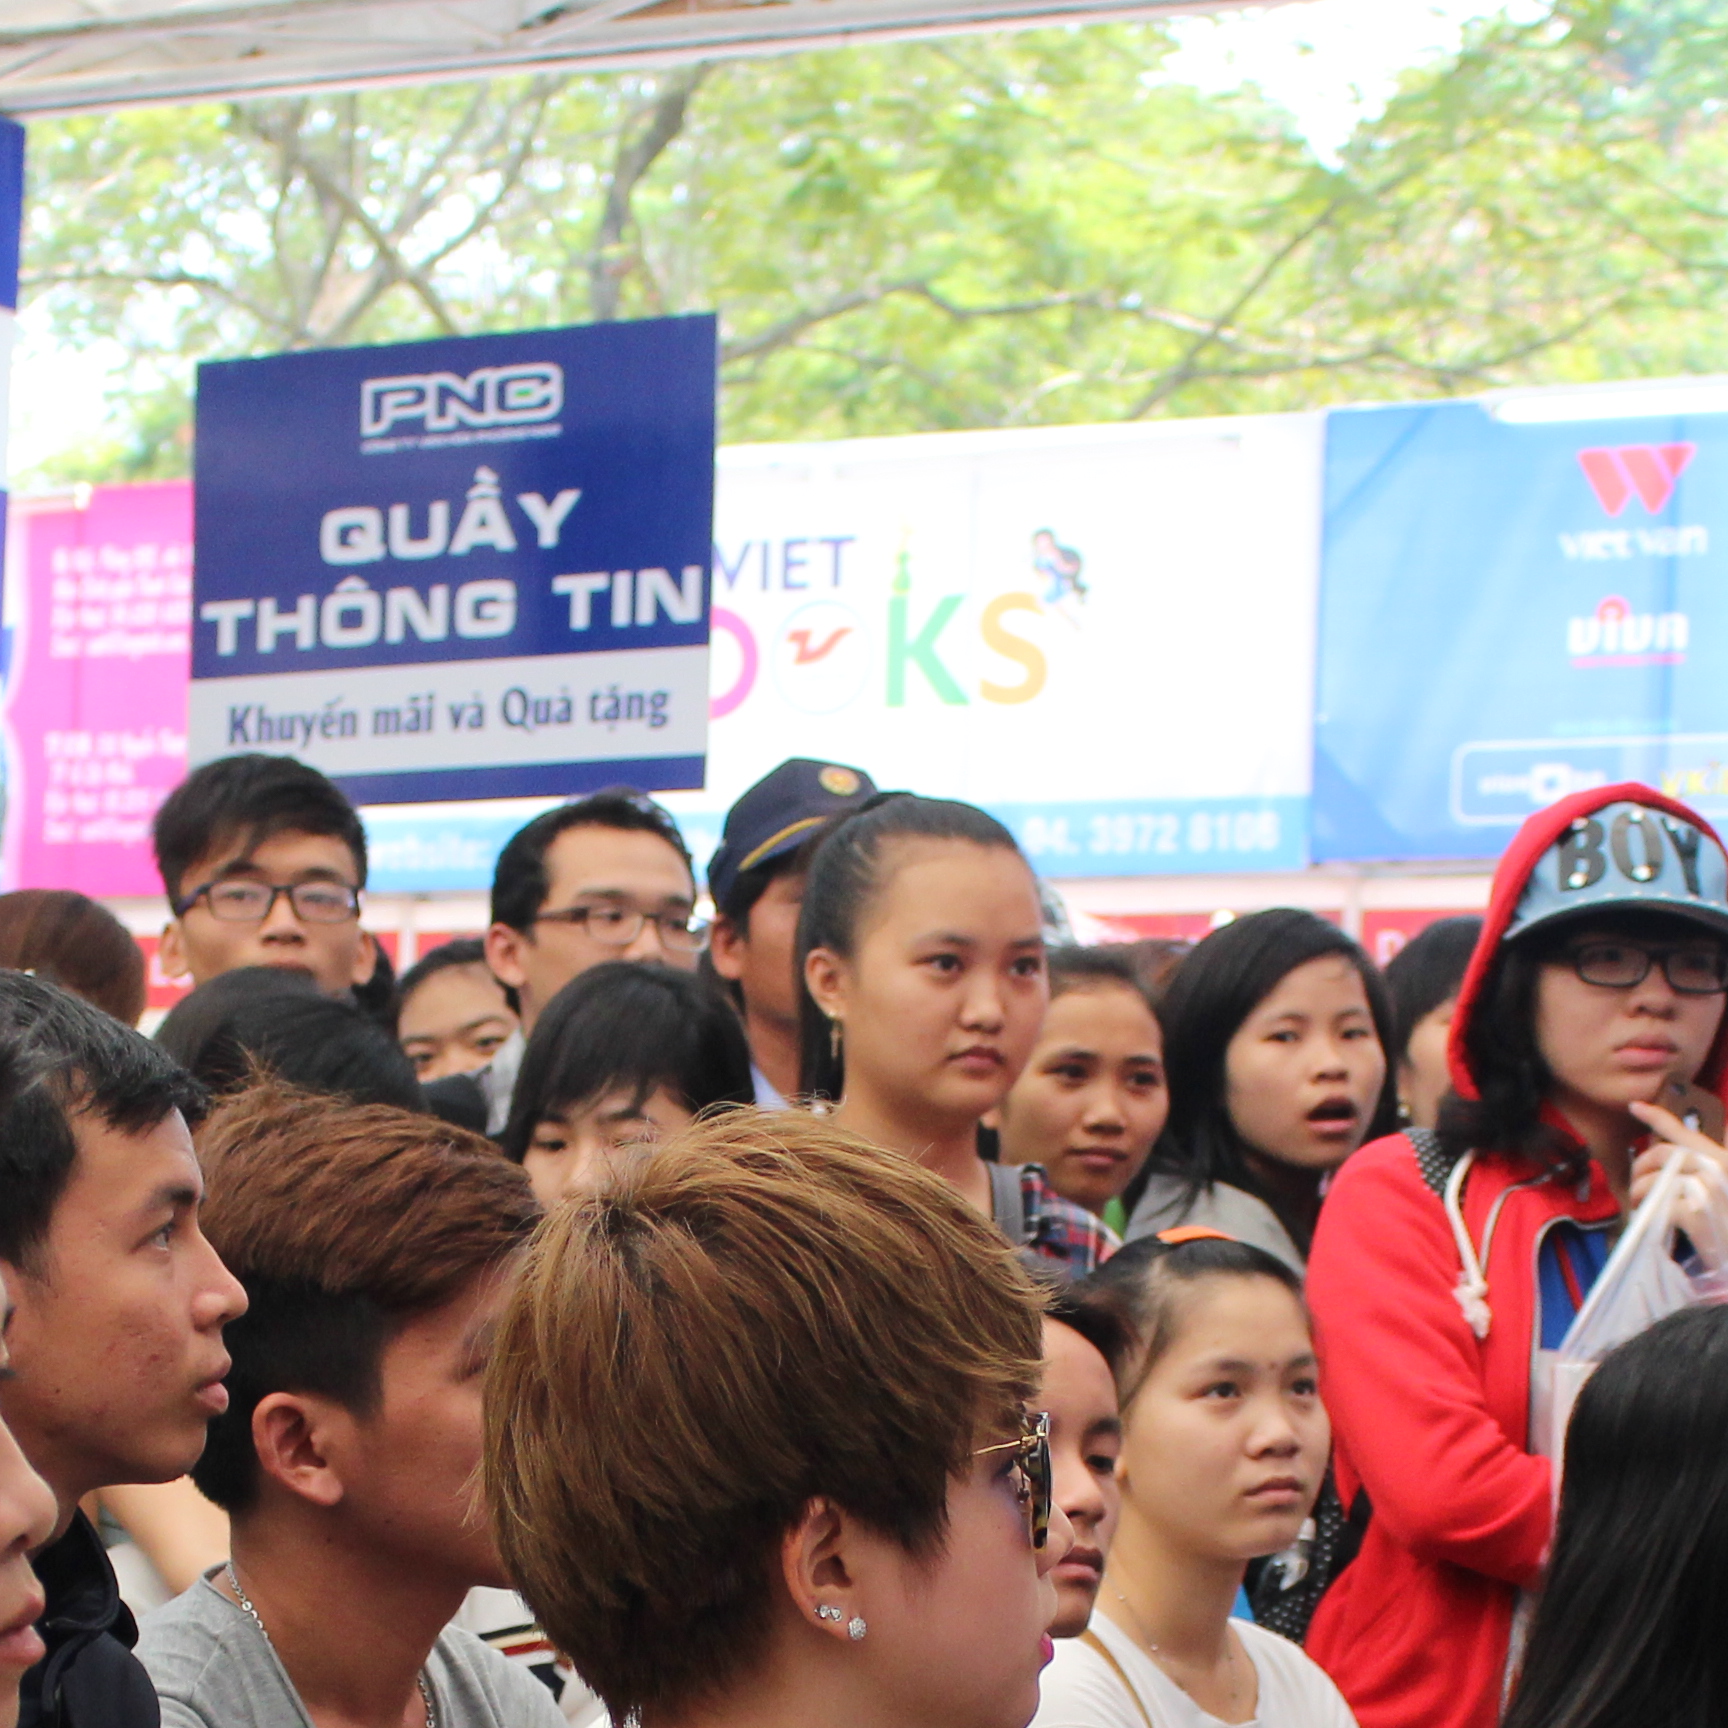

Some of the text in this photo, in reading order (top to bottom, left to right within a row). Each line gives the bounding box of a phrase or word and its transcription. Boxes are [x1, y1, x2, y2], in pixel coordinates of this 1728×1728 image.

[360, 361, 564, 438] PNC
[321, 466, 582, 566] QUẦY
[711, 535, 856, 592] VIET
[201, 575, 517, 657] THÔNG
[553, 564, 703, 634] TIN
[227, 698, 358, 752] Khuyến
[372, 690, 434, 738] mãi
[450, 690, 484, 730] và
[502, 683, 572, 736] Quà
[590, 686, 669, 737] tặng
[1555, 808, 1702, 898] BOY
